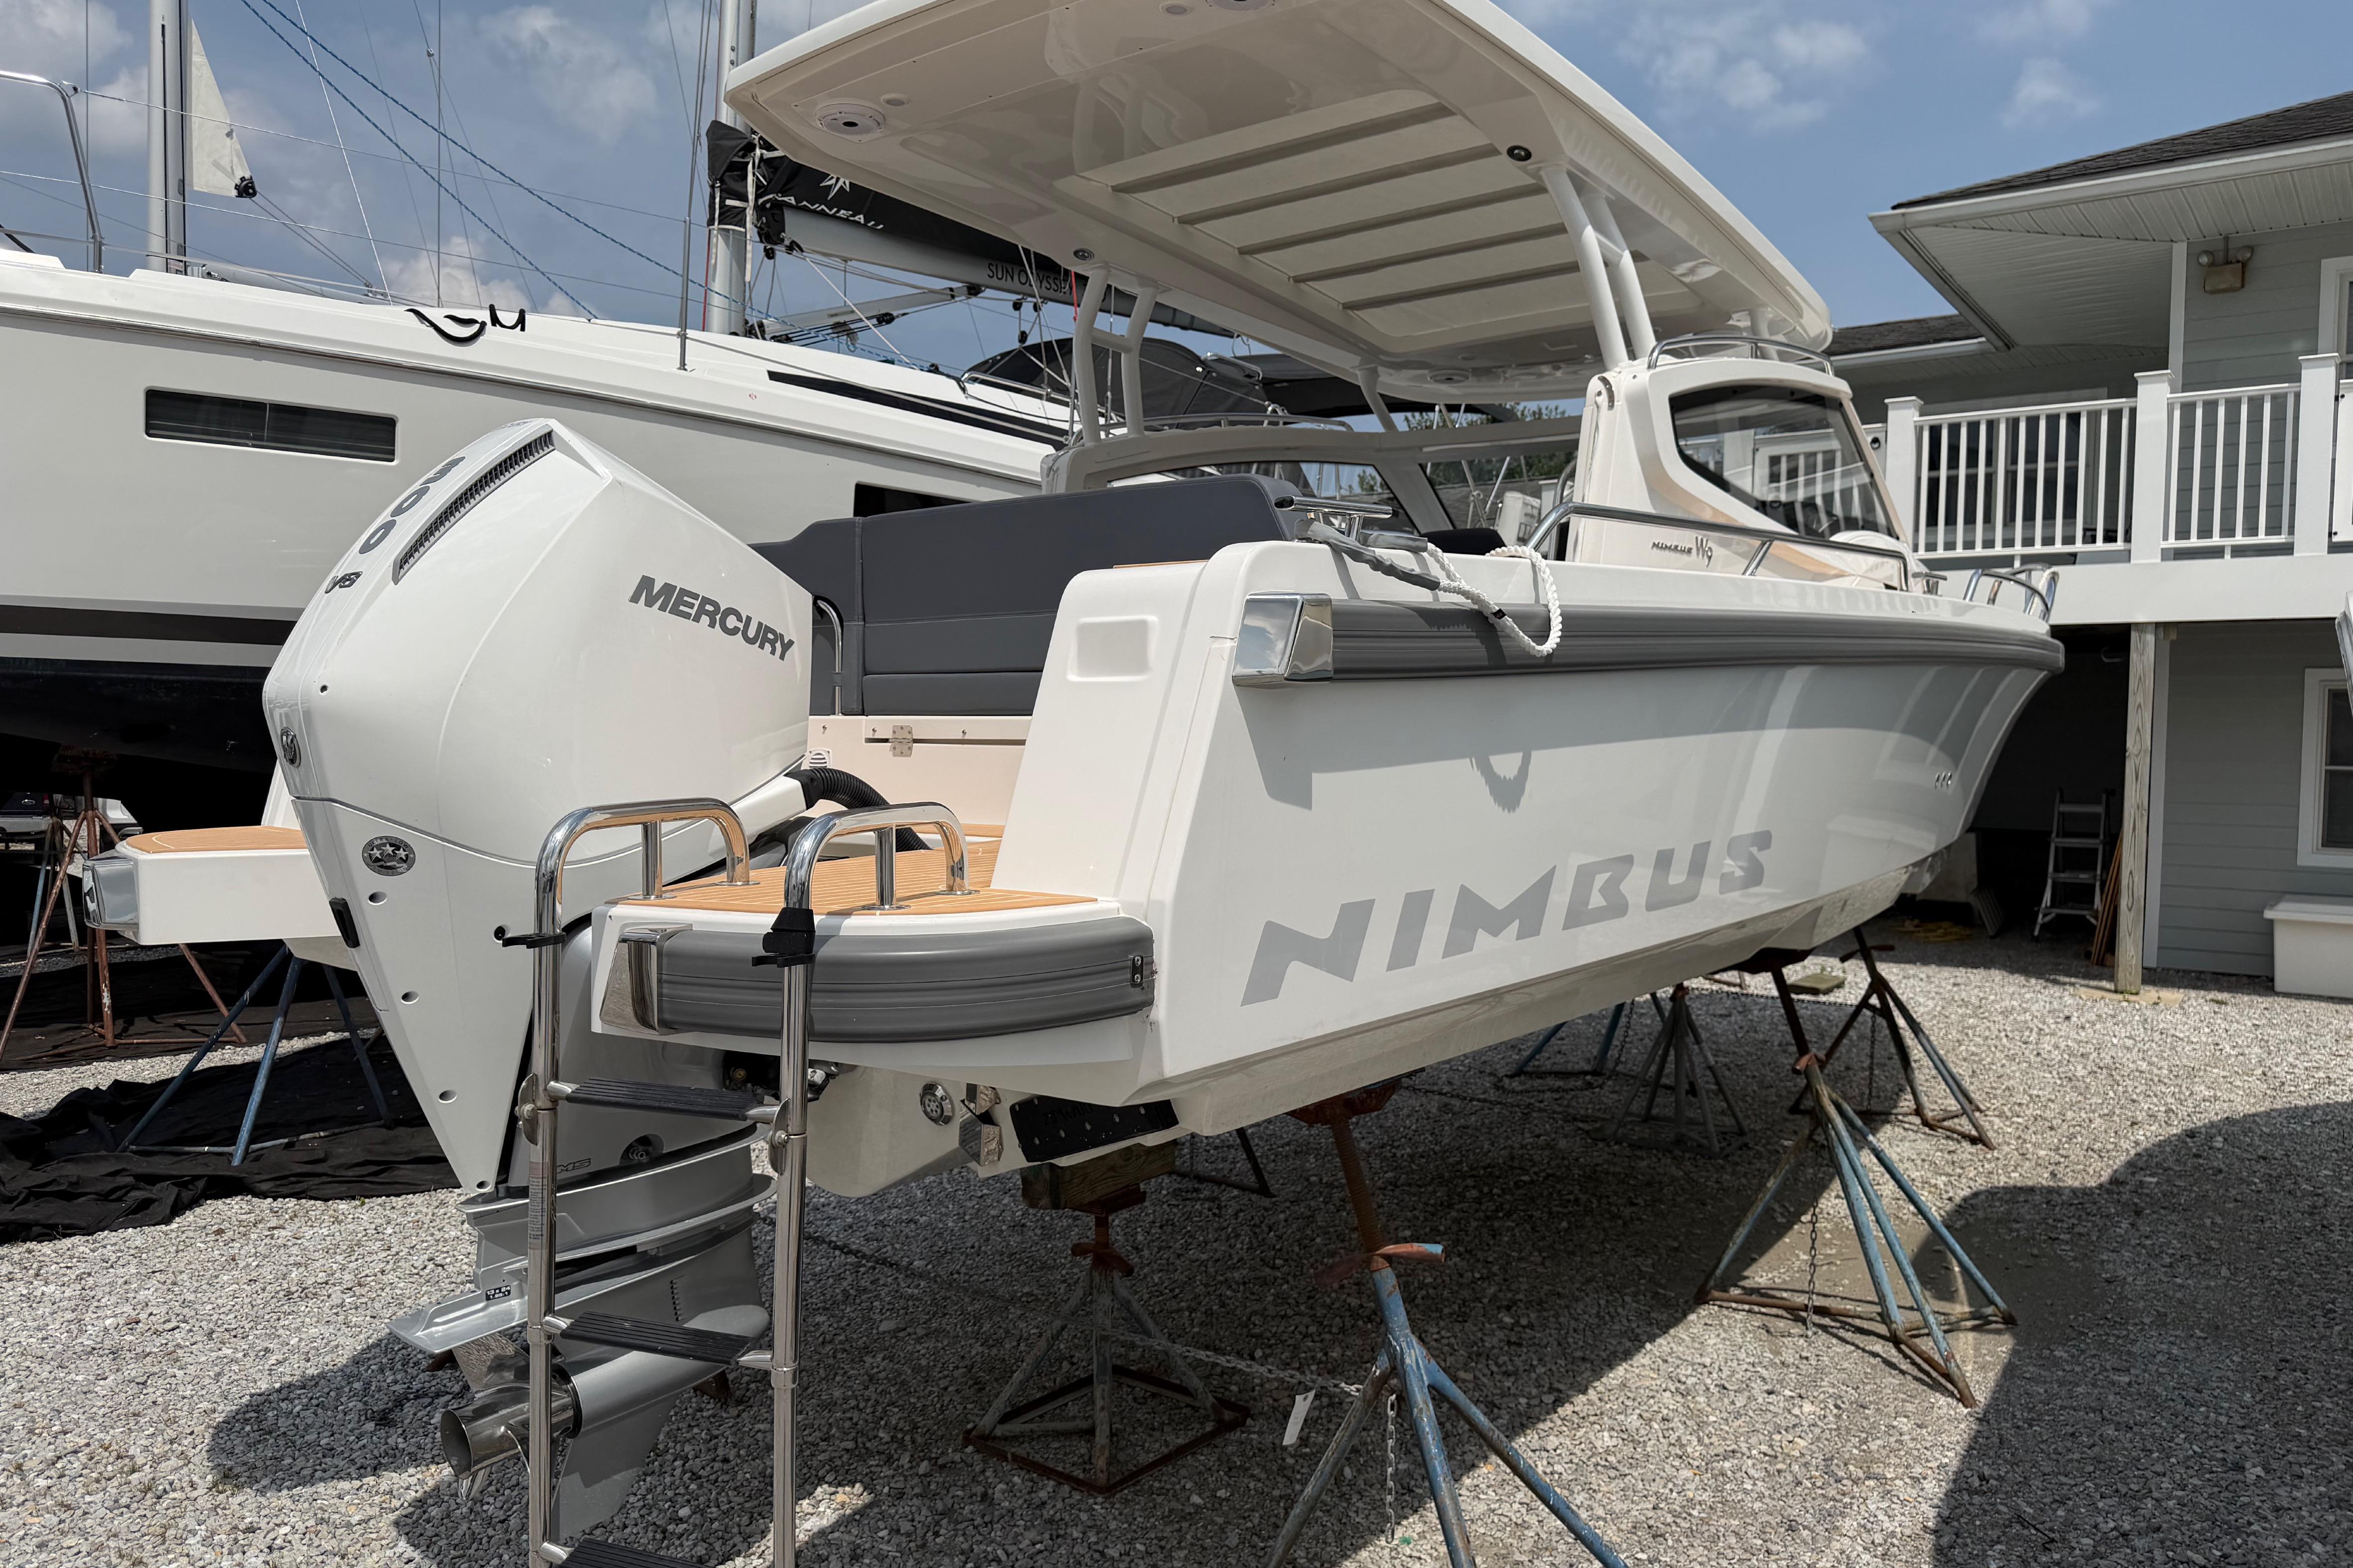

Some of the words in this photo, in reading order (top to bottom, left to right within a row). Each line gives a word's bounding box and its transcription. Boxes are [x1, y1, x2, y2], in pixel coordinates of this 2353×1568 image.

[988, 263, 1014, 283] SUN
[358, 456, 466, 555] 300
[1651, 541, 1693, 556] NIMBUS
[1695, 536, 1713, 568] W9
[628, 575, 795, 662] MERCURY
[368, 837, 389, 847] ULTRA
[395, 839, 409, 849] LOW
[1240, 829, 1772, 1007] NIMBUS
